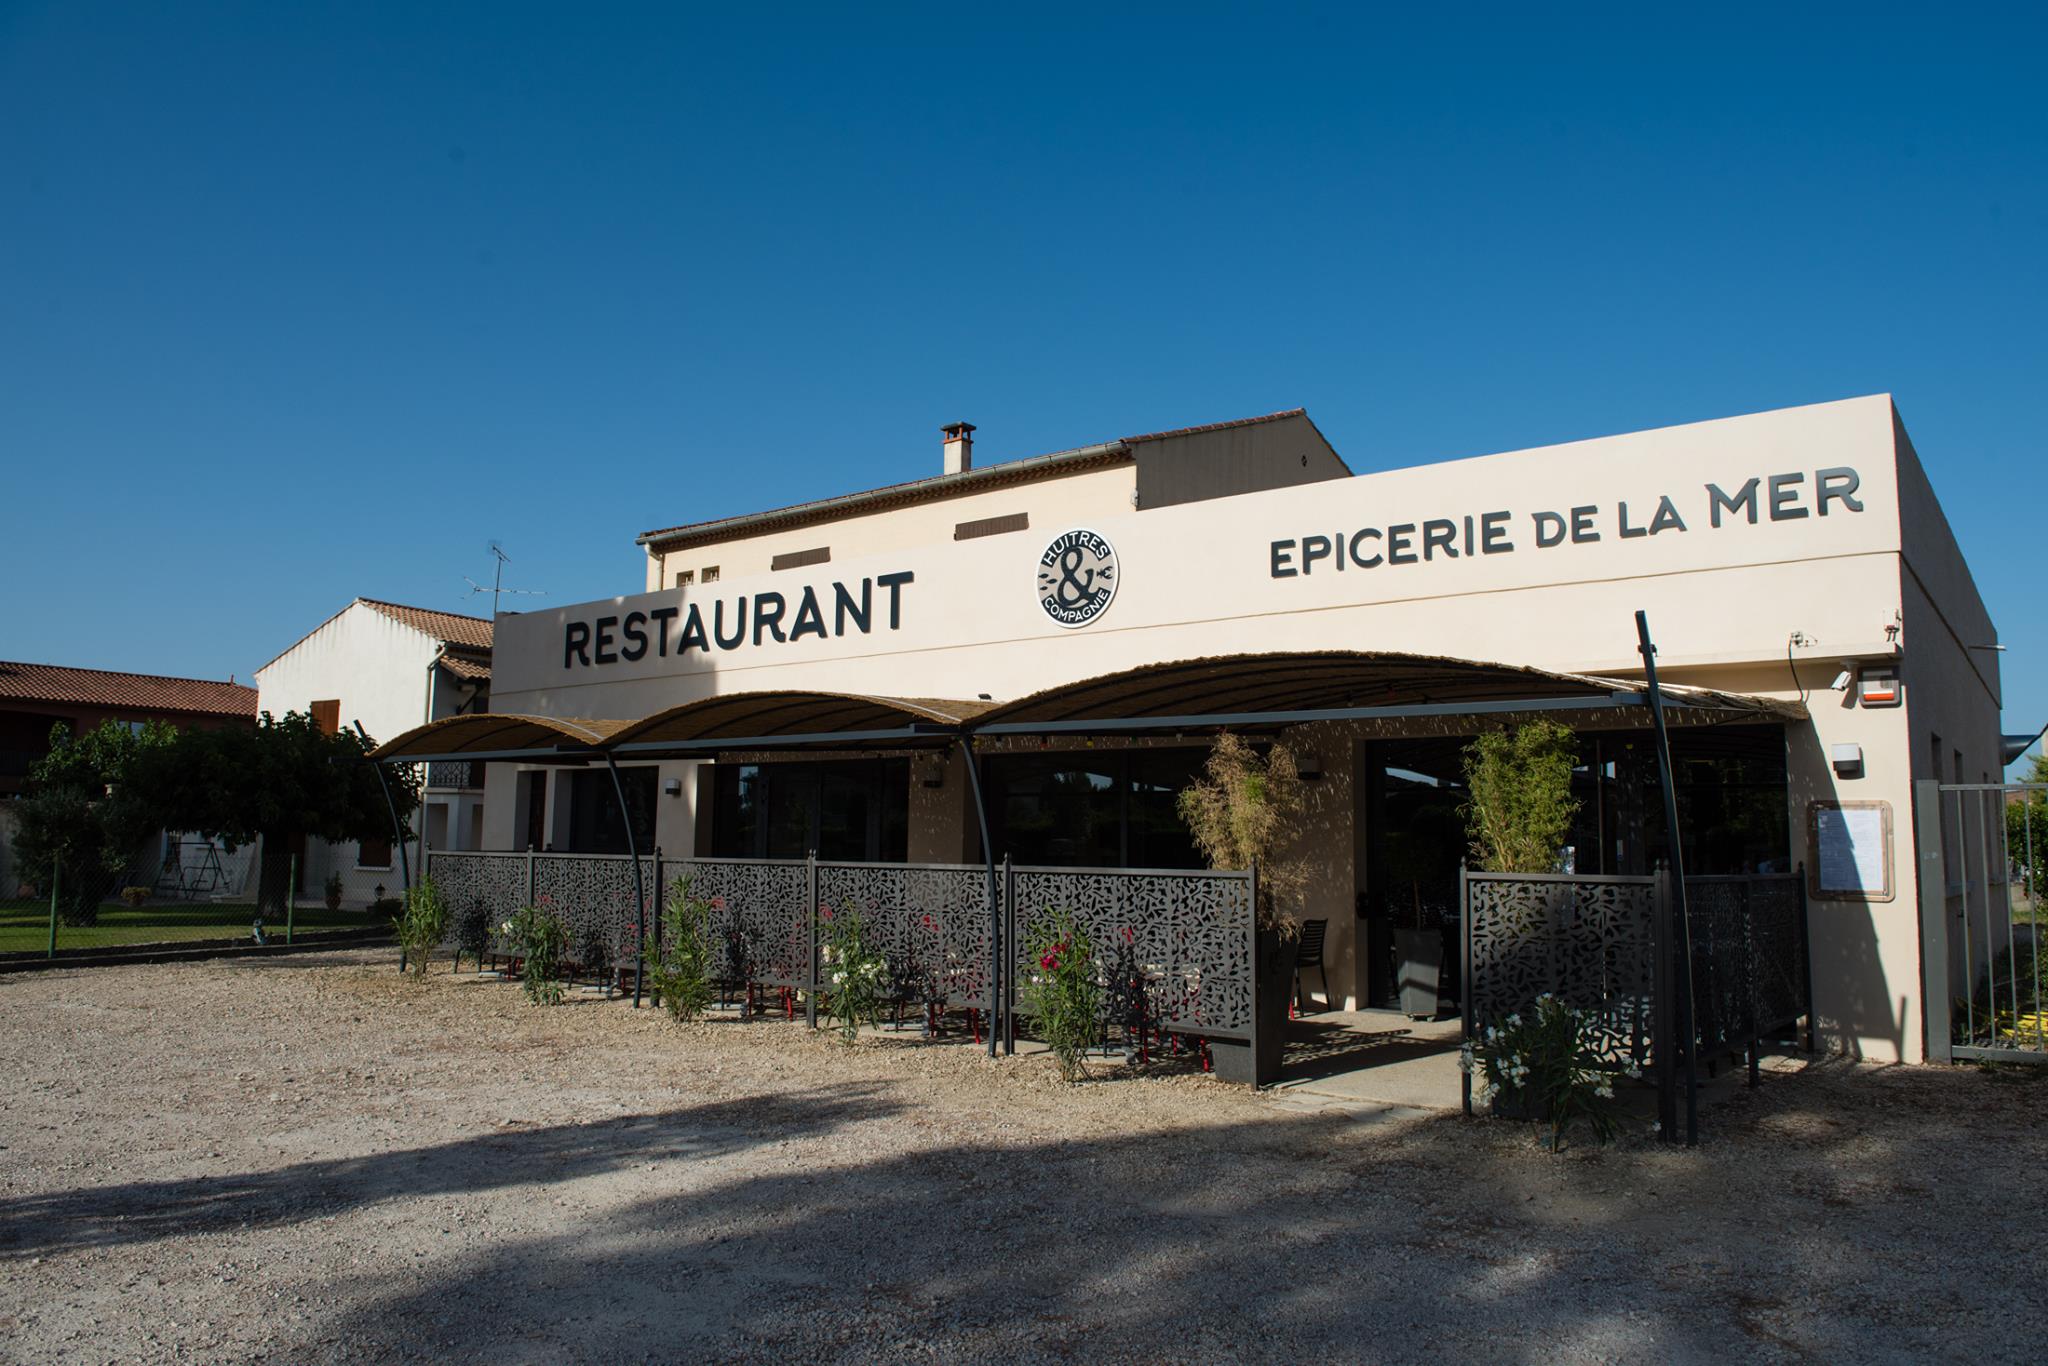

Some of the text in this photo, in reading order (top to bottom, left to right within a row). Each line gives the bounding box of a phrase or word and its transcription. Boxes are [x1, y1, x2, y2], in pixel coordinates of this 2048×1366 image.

[1043, 531, 1108, 565] HUITRES
[1270, 466, 1864, 578] EPICERIE DE LA MER
[1044, 589, 1108, 622] COMPAGNIE
[1057, 547, 1100, 607] &
[564, 570, 914, 669] RESTAURANT
